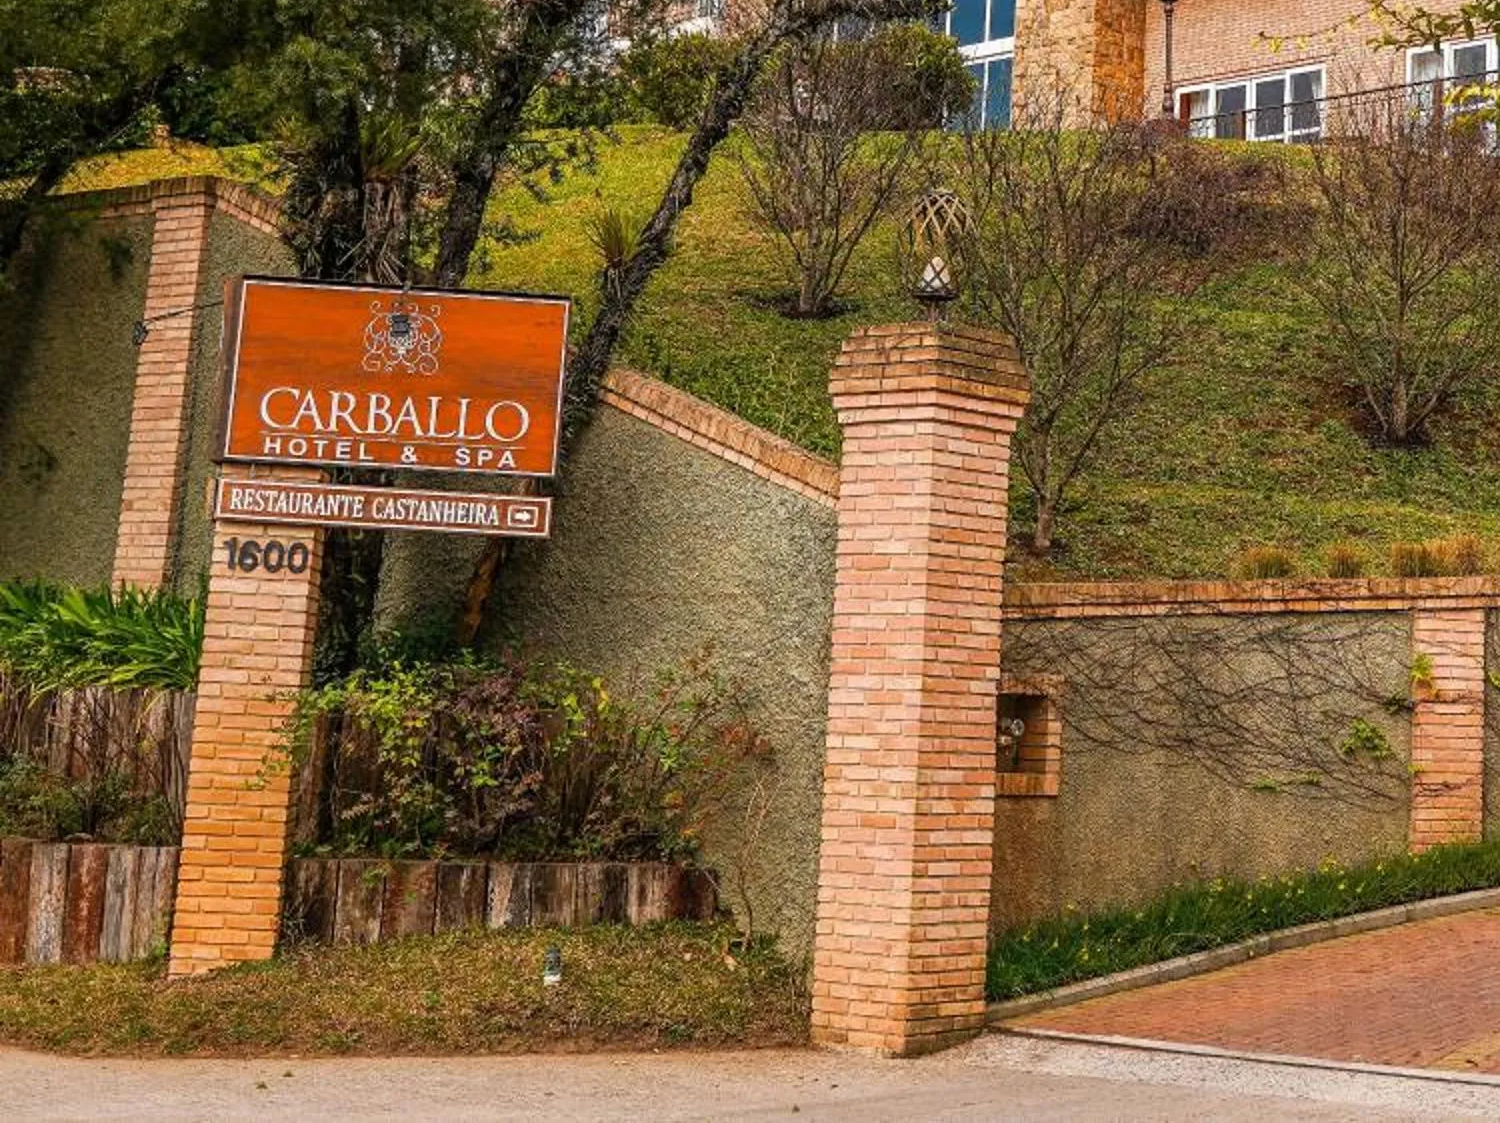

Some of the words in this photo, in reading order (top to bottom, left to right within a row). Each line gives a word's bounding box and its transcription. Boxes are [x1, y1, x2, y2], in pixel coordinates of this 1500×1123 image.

[259, 386, 530, 441] CARBALLO
[263, 437, 374, 460] HOTEL
[400, 446, 417, 463] &
[455, 447, 518, 468] SPA
[230, 487, 365, 519] RESTAURANTE
[372, 496, 500, 526] CASTANHEIRA
[223, 536, 310, 574] 1600
